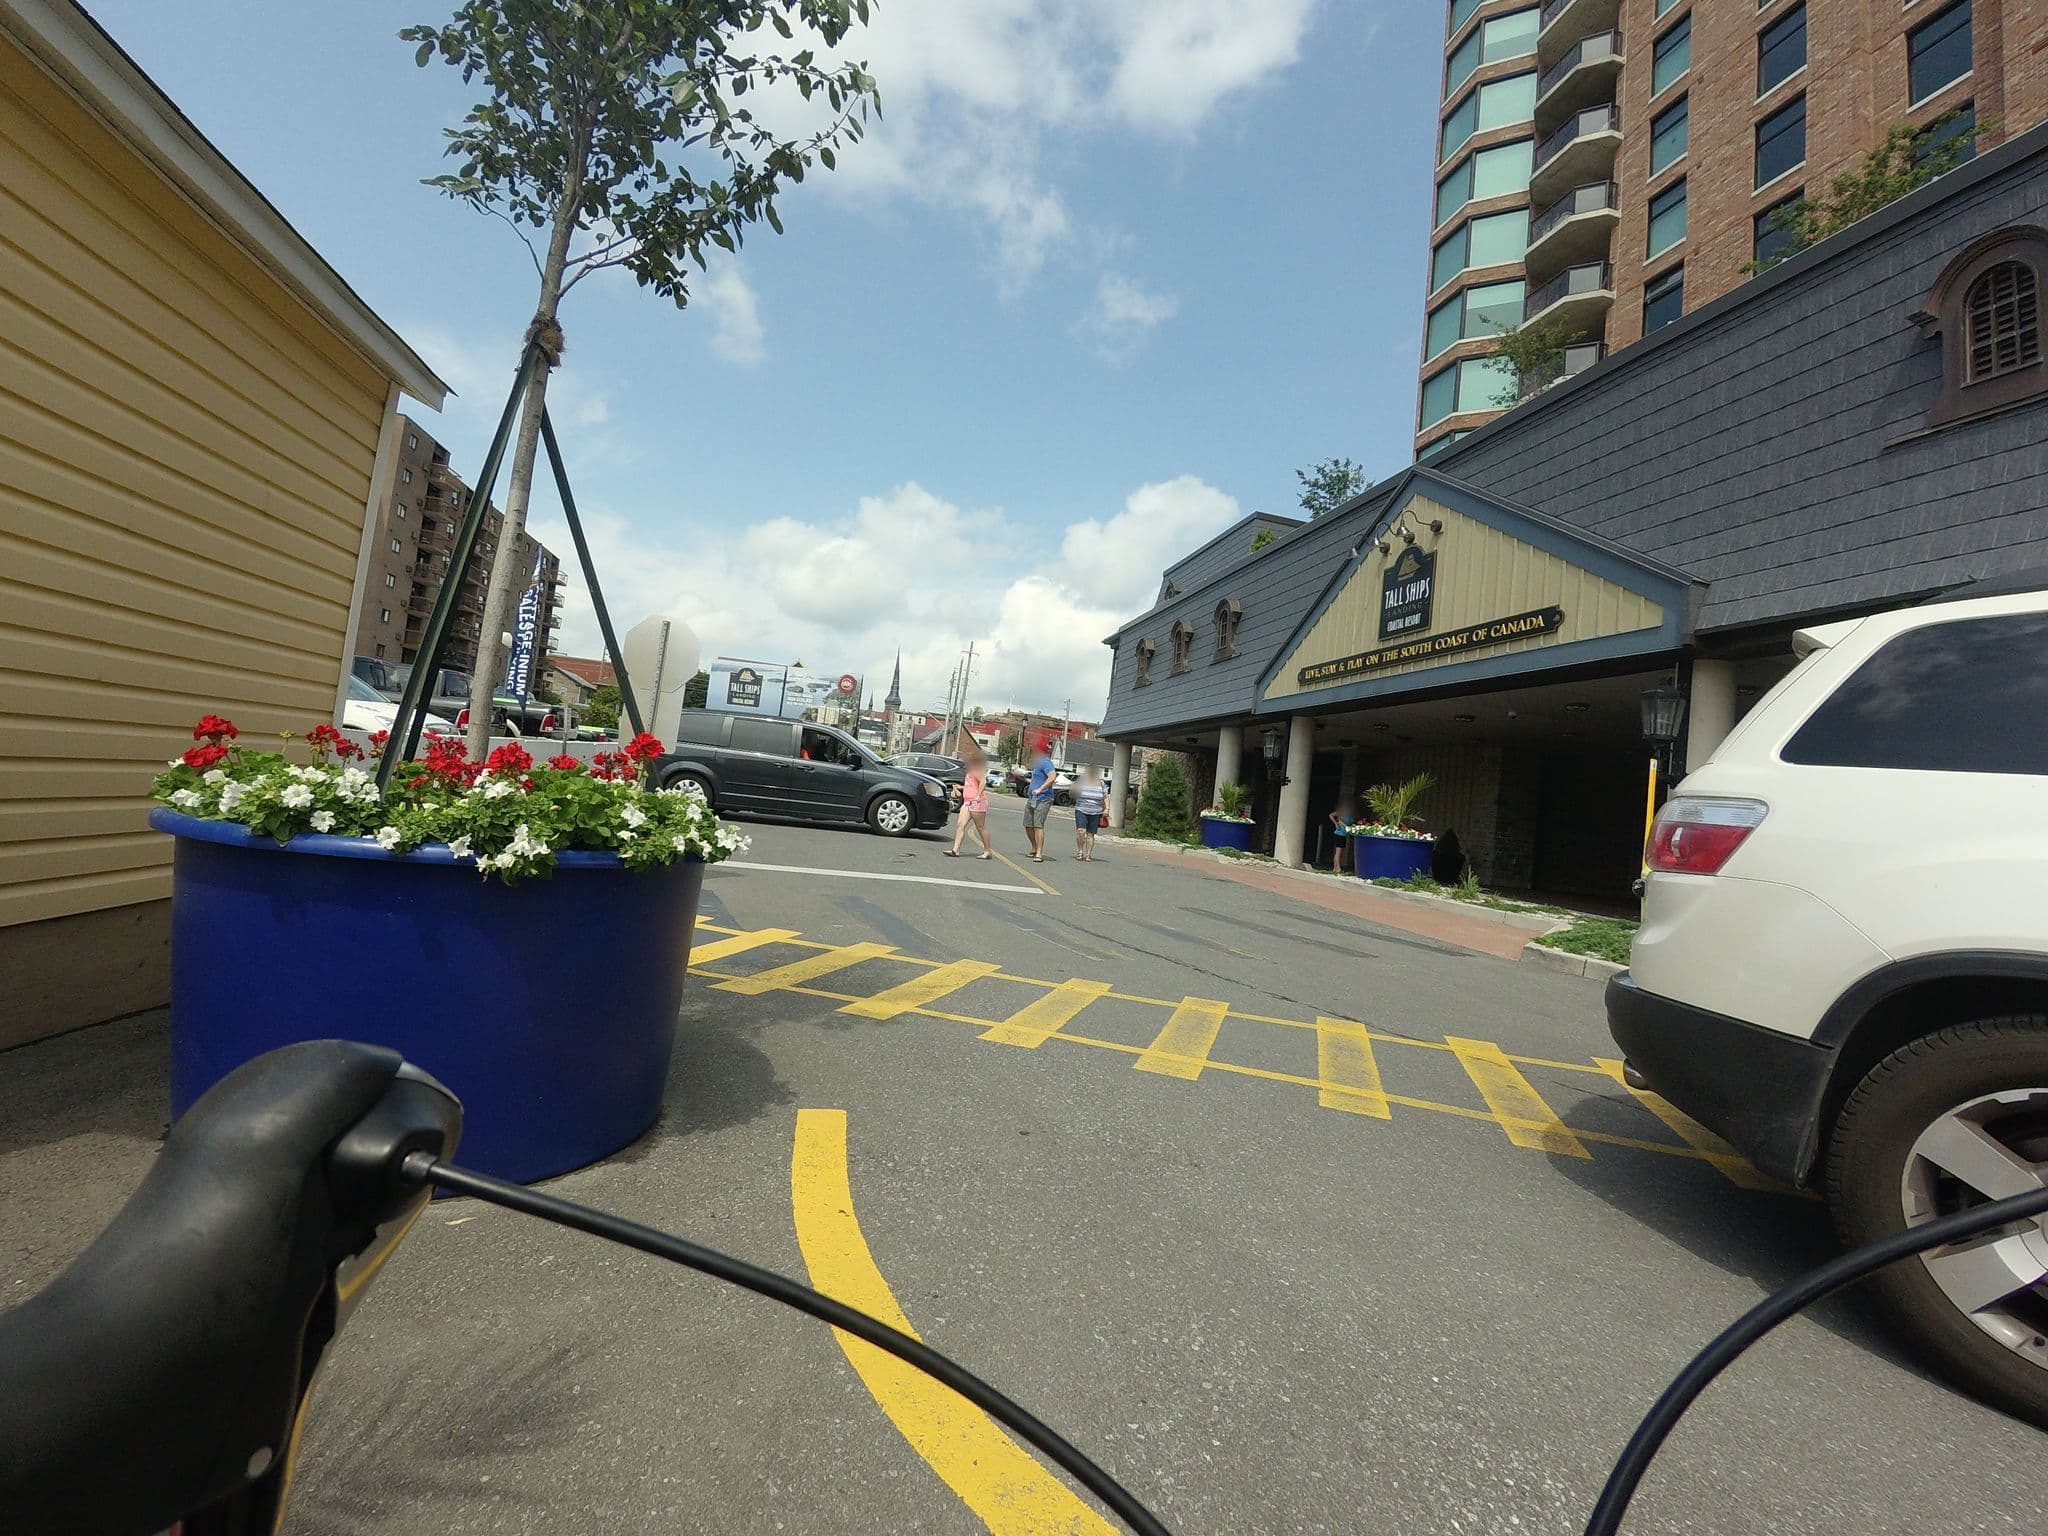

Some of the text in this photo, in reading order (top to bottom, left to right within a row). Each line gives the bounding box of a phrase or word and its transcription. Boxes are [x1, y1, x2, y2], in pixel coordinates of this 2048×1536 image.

[1385, 577, 1430, 609] TALL SHIPS
[1321, 664, 1338, 675] STAY
[1339, 662, 1345, 671] &
[1347, 657, 1365, 670] PLAY
[1365, 653, 1380, 665] ON
[1382, 649, 1399, 662] THE
[1400, 641, 1432, 658] SOUTH
[1435, 632, 1469, 650] COAST
[1472, 627, 1487, 641] OF
[1491, 615, 1545, 638] CANADA
[730, 682, 761, 695] TALL SHIPS
